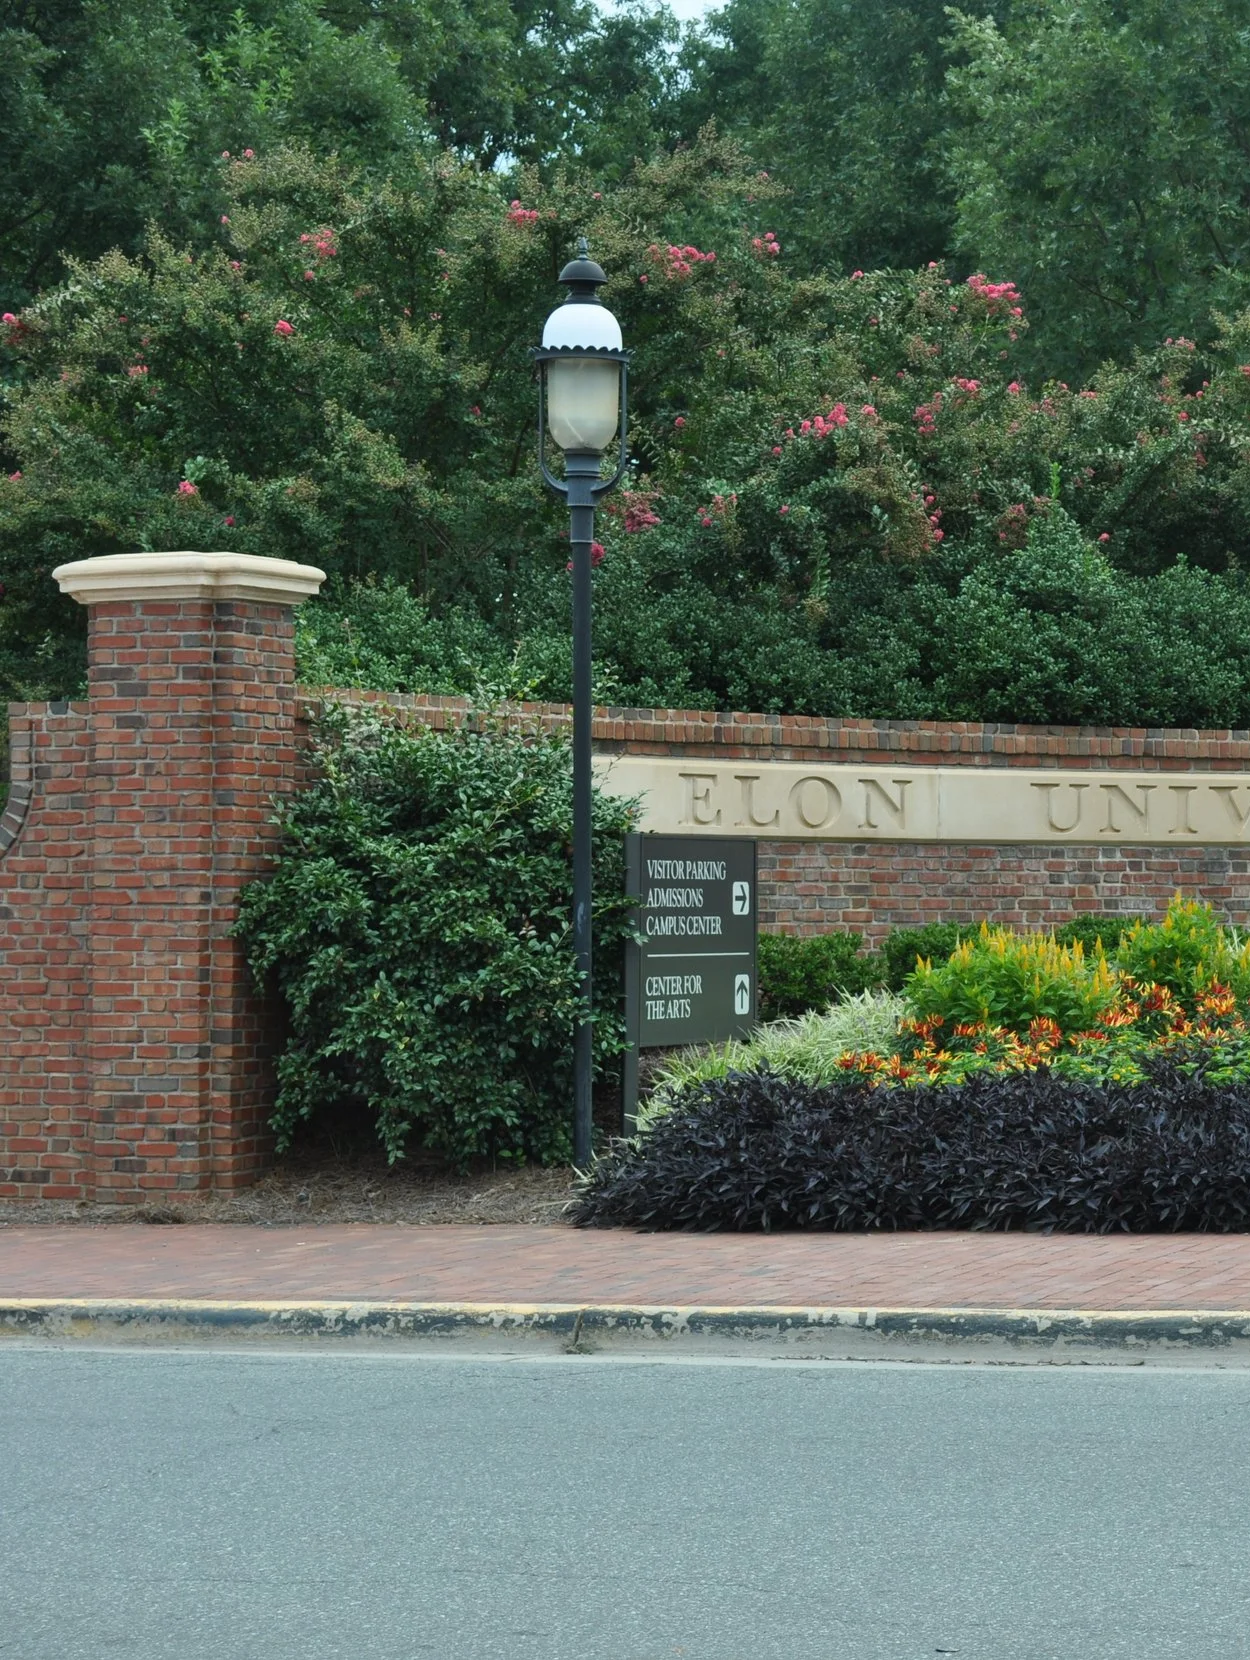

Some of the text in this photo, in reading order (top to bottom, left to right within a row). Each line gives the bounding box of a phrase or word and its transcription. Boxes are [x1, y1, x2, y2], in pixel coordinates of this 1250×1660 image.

[677, 772, 912, 830] ELON
[647, 859, 726, 880] VISITOR PARKING
[647, 888, 703, 907] ADMISSIONS
[646, 916, 722, 935] CAMPUS CENTER
[646, 975, 702, 996] CENTER FOR
[646, 999, 691, 1020] THE ARTS
